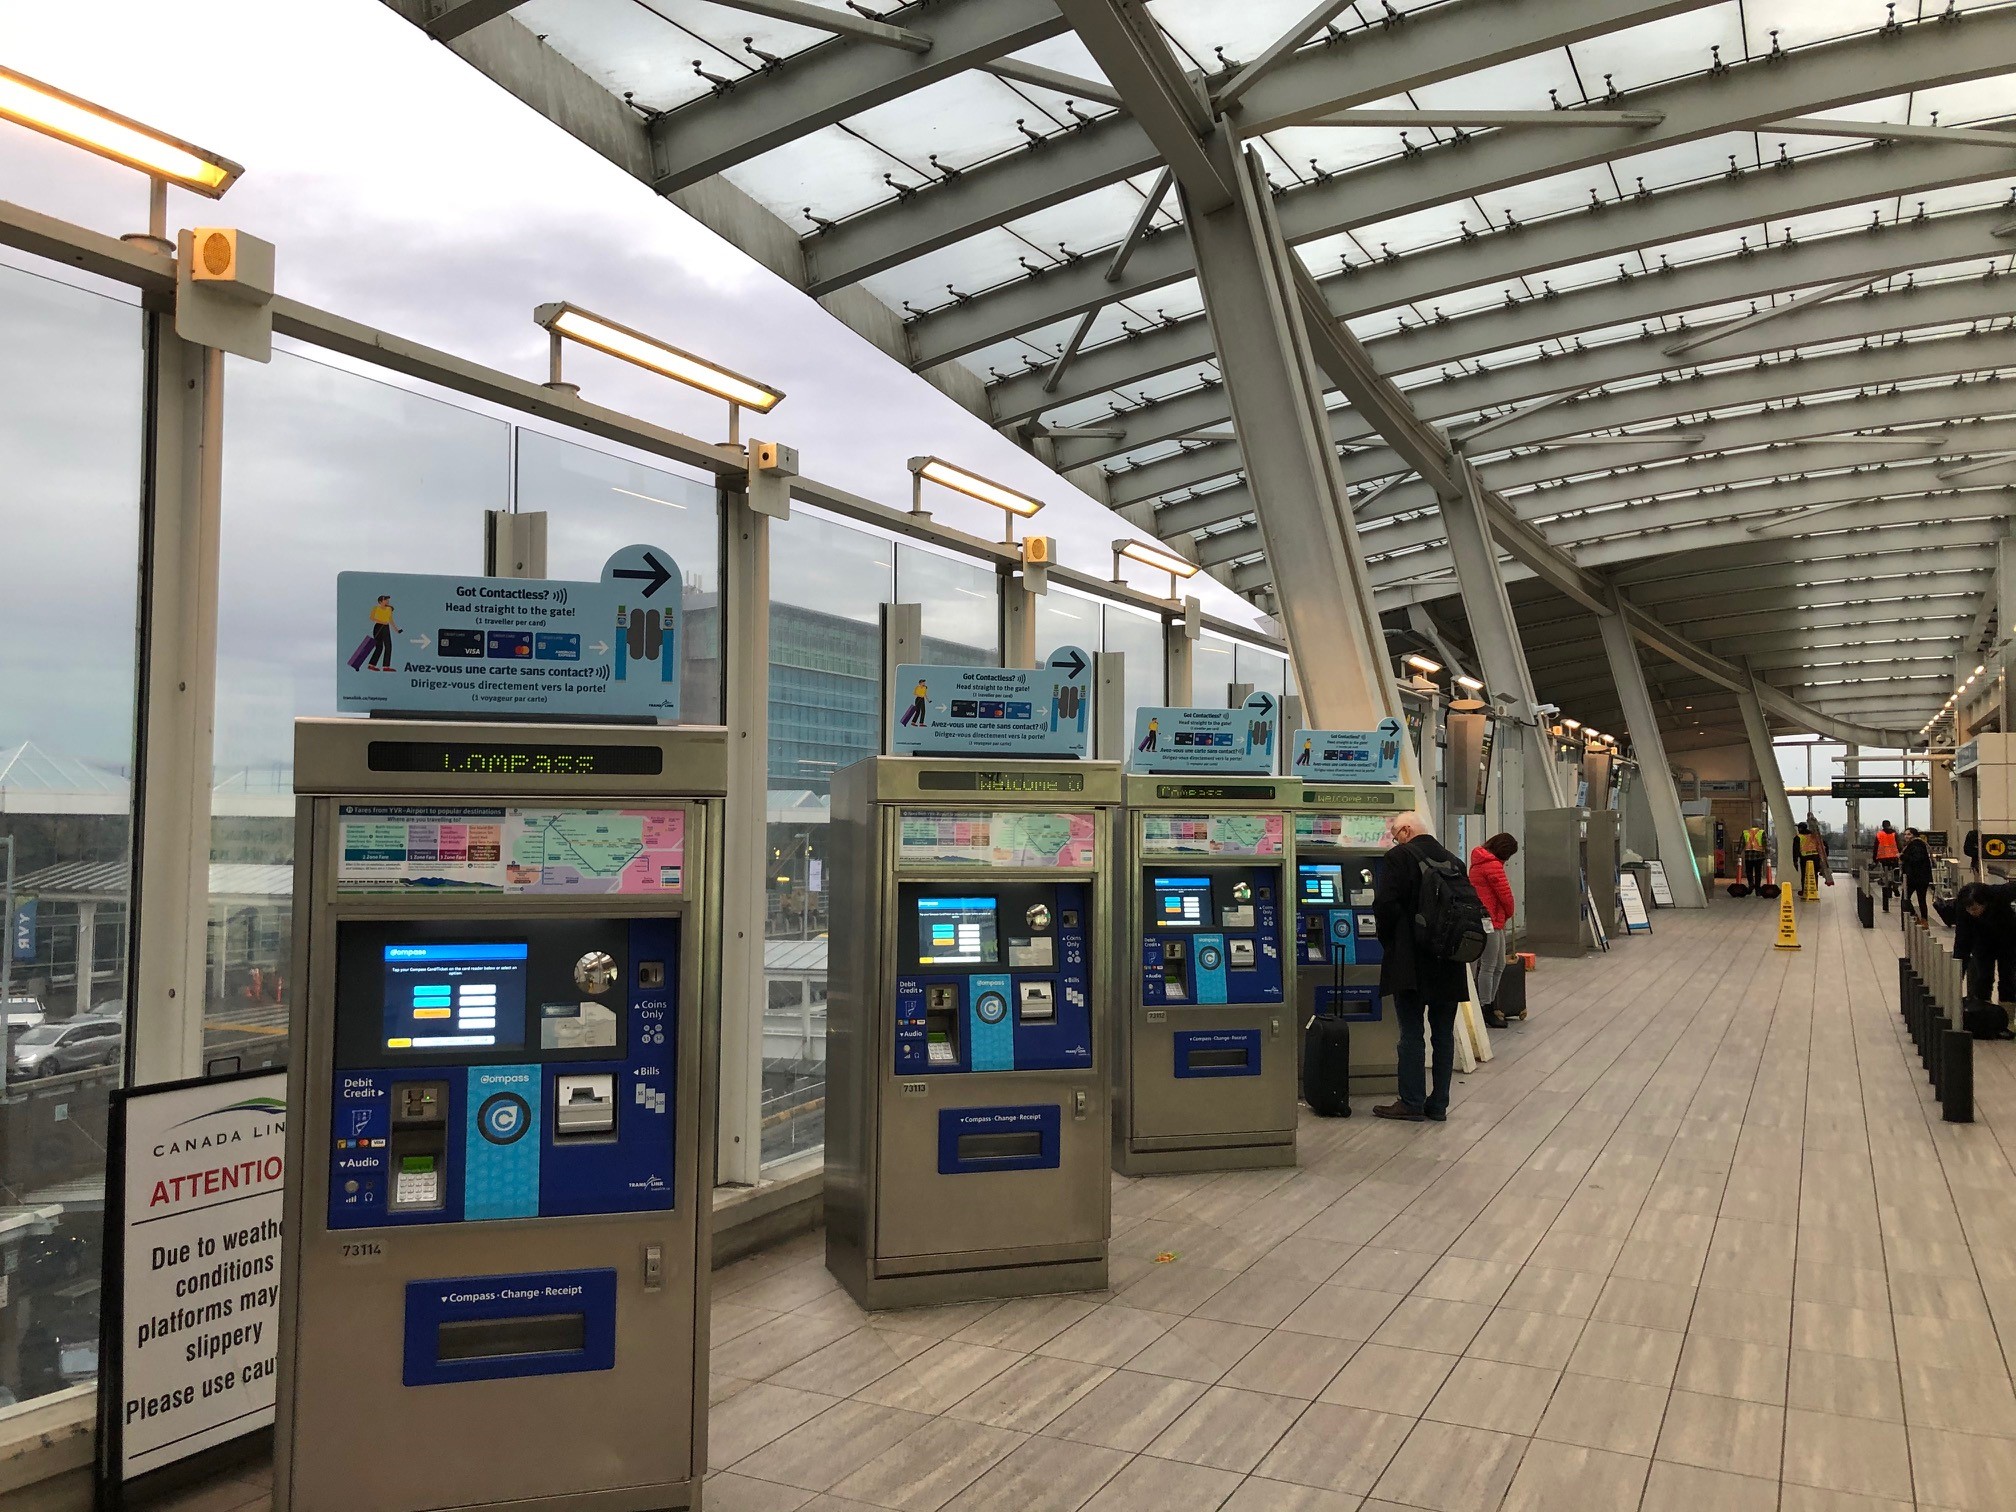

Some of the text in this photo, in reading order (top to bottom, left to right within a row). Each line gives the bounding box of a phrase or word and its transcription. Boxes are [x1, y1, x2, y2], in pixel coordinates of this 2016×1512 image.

[456, 586, 549, 600] Got Contactless?
[446, 602, 575, 618] Head straight to the gate!
[529, 619, 546, 627] card)
[404, 662, 593, 678] Avez-vous une carte sans contact?
[411, 678, 606, 694] Dirigez-vous directement vers la porte!
[472, 694, 478, 702] (1
[479, 695, 511, 704] voyageur
[527, 695, 548, 703] carte)
[642, 1000, 667, 1009] Coins
[642, 1010, 663, 1020] Only
[641, 1067, 659, 1075] Bills
[345, 1078, 372, 1087] Debit
[480, 1074, 529, 1084] Compass
[344, 1088, 375, 1098] Credit
[153, 1131, 241, 1157] CANADA
[348, 1158, 379, 1168] Audio
[150, 1156, 283, 1207] ATTENTIO
[152, 1244, 190, 1270] Due
[198, 1237, 215, 1258] to
[343, 1244, 381, 1256] 73114
[176, 1254, 274, 1297] conditions
[450, 1286, 582, 1304] Compass Change Receipt
[138, 1285, 278, 1348] platforms may
[186, 1322, 263, 1362] slippery
[126, 1356, 277, 1424] Please use cau
